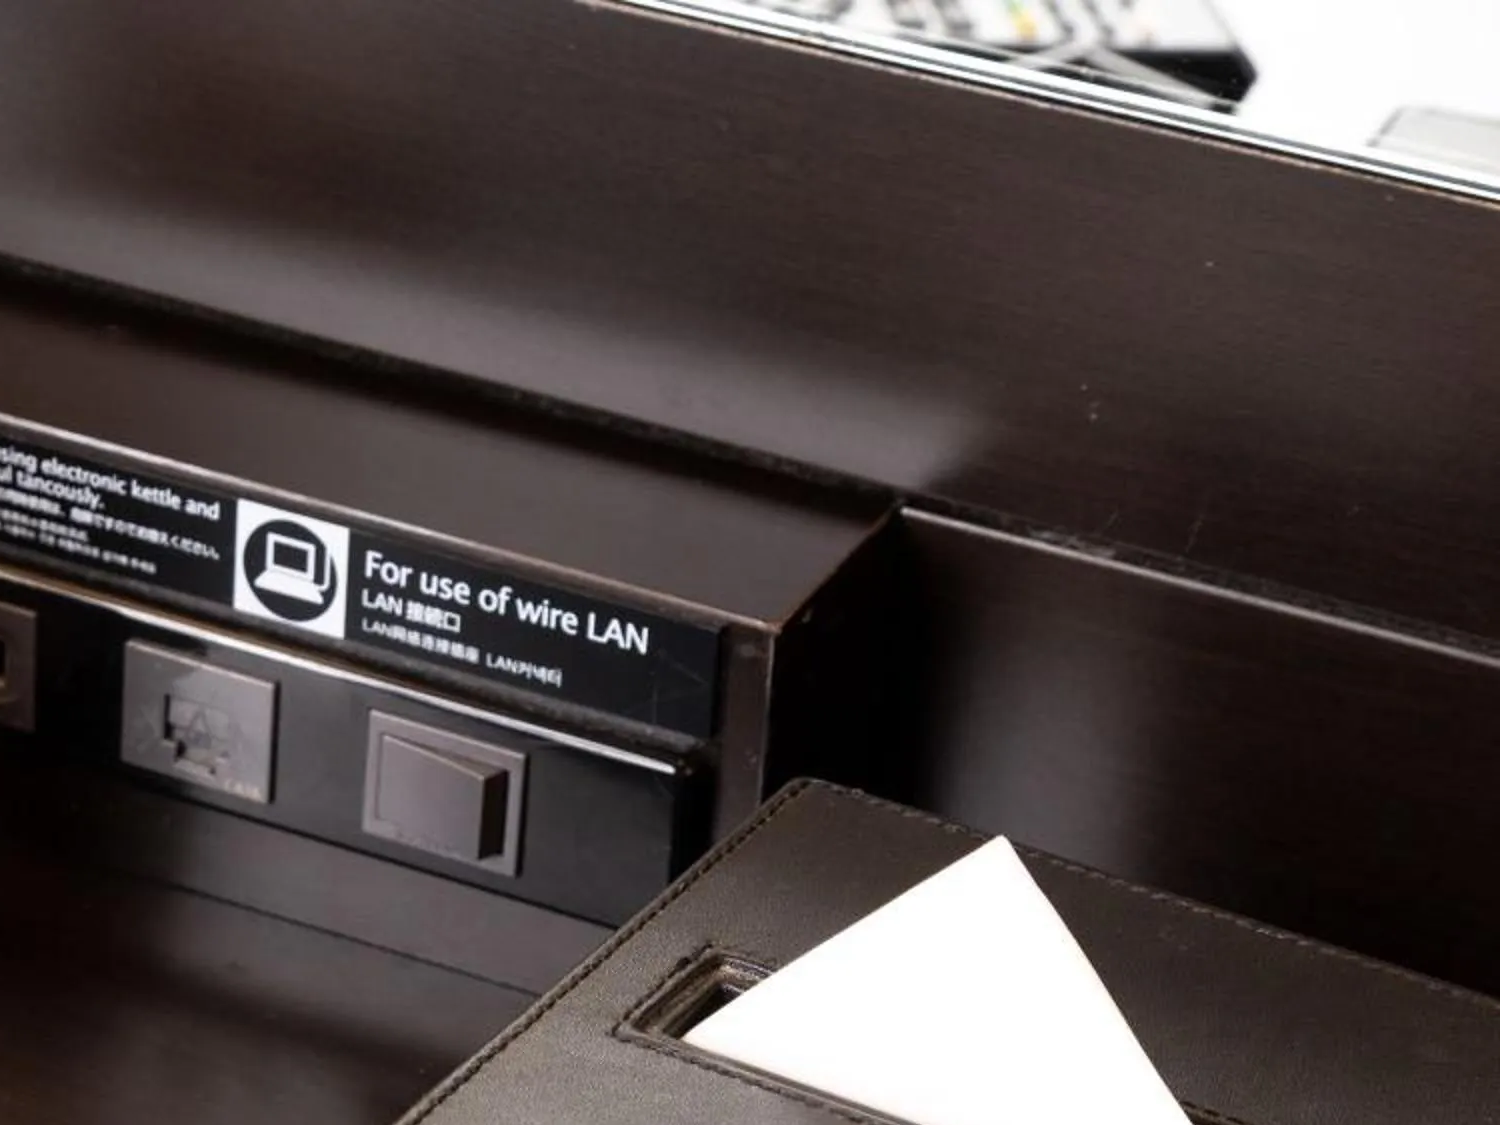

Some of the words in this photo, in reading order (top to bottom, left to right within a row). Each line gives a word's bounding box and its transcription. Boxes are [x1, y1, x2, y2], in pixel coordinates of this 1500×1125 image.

[40, 456, 127, 496] electronic
[131, 479, 182, 511] kettle
[185, 497, 220, 521] and
[361, 588, 403, 617] LAN
[365, 550, 412, 588] For
[419, 570, 471, 605] use
[477, 585, 512, 616] of
[516, 598, 579, 635] wire
[587, 612, 649, 655] LAN
